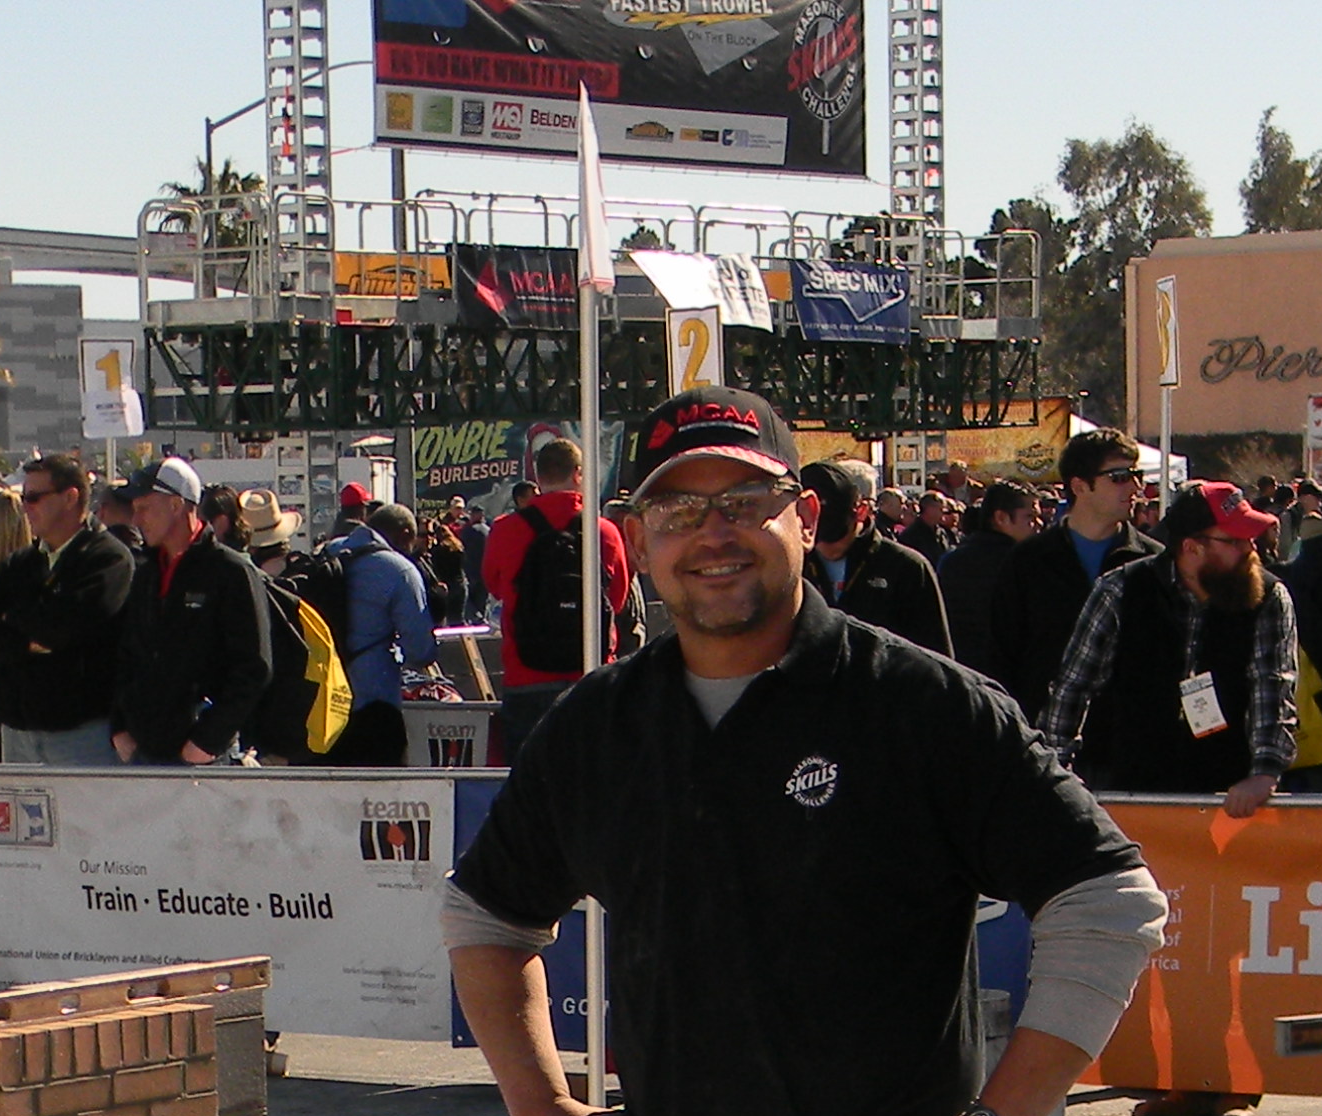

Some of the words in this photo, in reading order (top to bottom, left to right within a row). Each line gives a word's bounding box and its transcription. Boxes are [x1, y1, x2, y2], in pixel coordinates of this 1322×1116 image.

[795, 0, 845, 45] MASONRY
[726, 33, 757, 46] BLOCK
[787, 15, 858, 91] SKILLS
[802, 60, 856, 117] CHALLENGE
[530, 109, 577, 129] BELDEN
[509, 270, 574, 295] MCAA
[809, 270, 861, 293] SPEC
[678, 317, 711, 392] 2
[95, 349, 121, 392] 1
[677, 402, 760, 429] MCAA
[414, 421, 514, 479] ZOMBIE
[429, 460, 519, 488] BURLESQUE
[427, 723, 476, 738] team
[785, 763, 838, 795] SKILLS
[361, 797, 430, 819] team
[79, 859, 100, 874] Our
[104, 860, 148, 876] Mission
[82, 885, 138, 912] Train
[157, 888, 250, 918] Educate
[268, 893, 334, 920] Build
[35, 951, 60, 960] Union
[62, 951, 72, 961] of
[73, 952, 120, 964] Bricklayers
[121, 954, 137, 964] and
[139, 954, 162, 965] Allied
